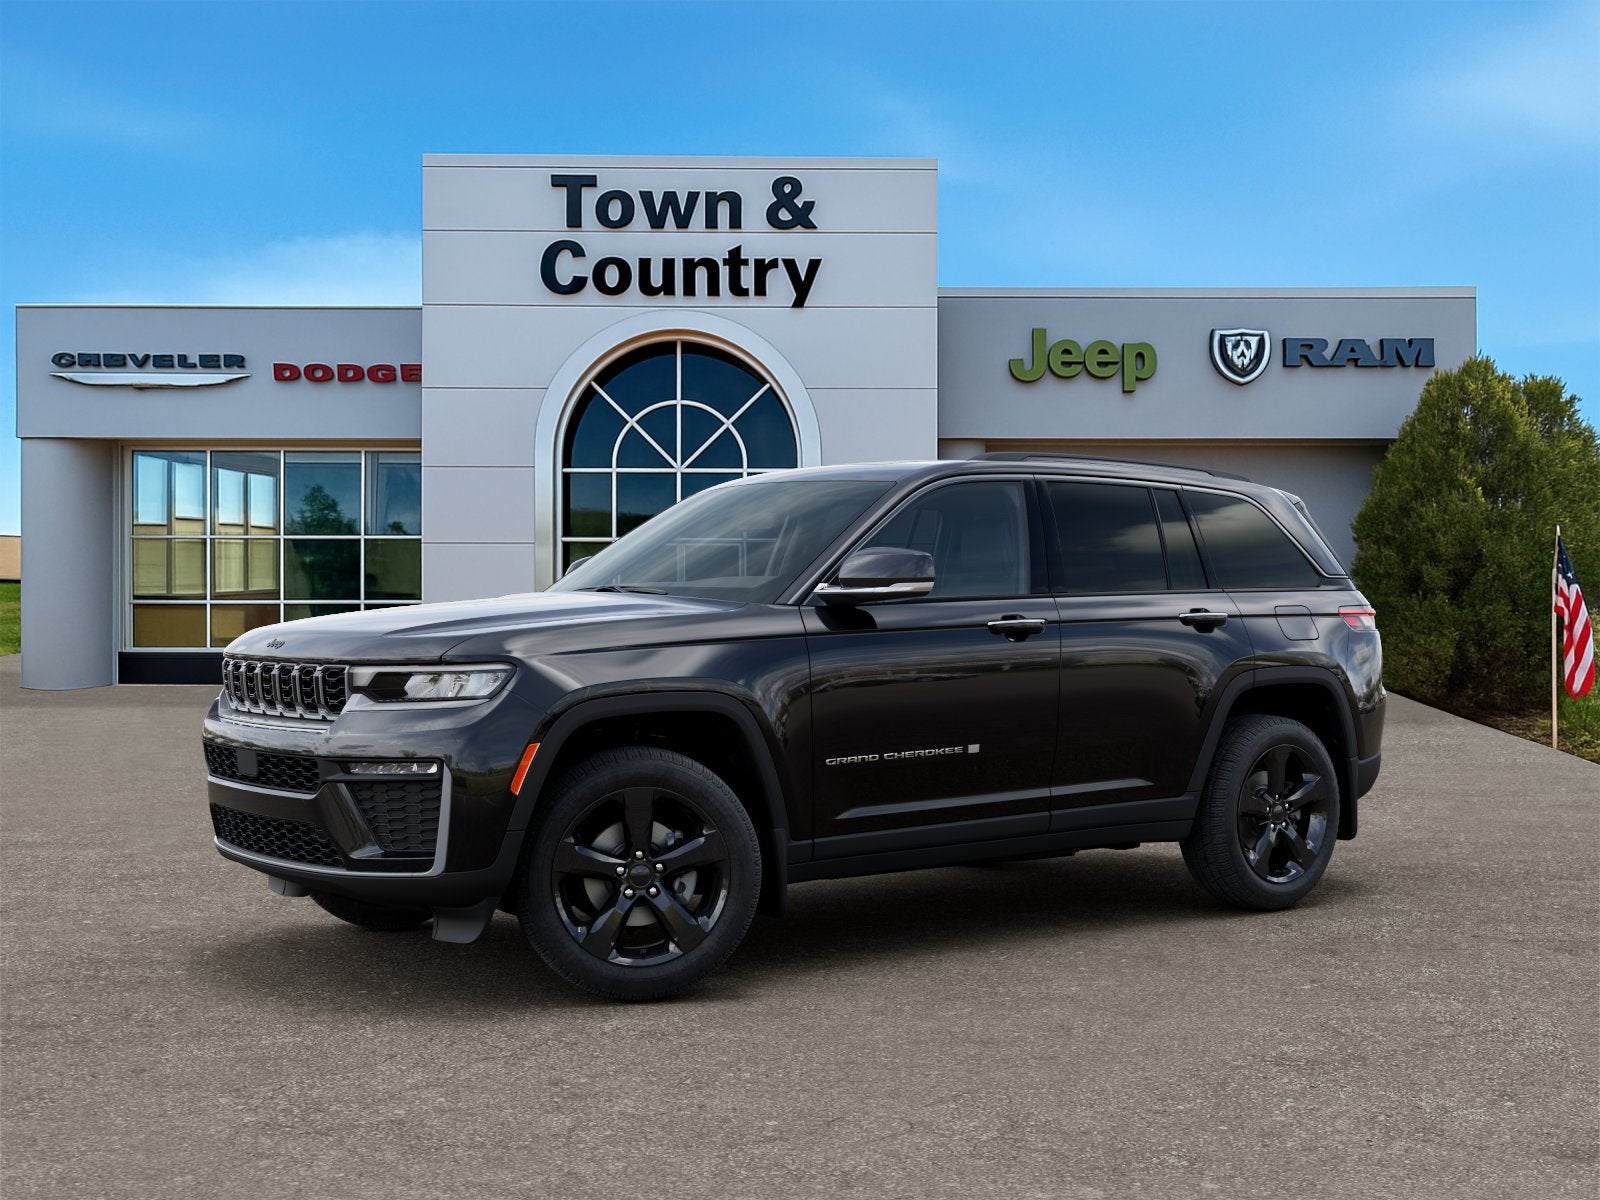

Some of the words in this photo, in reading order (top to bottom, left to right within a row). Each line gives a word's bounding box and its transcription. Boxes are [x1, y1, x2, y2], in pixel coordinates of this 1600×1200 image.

[550, 174, 743, 229] Town
[765, 176, 818, 230] &
[540, 239, 822, 308] Country
[273, 363, 422, 383] DODGE
[1008, 328, 1158, 393] Jeep
[1283, 338, 1435, 368] RAM
[825, 754, 879, 766] GRAND
[883, 746, 964, 760] CHEROKEE
